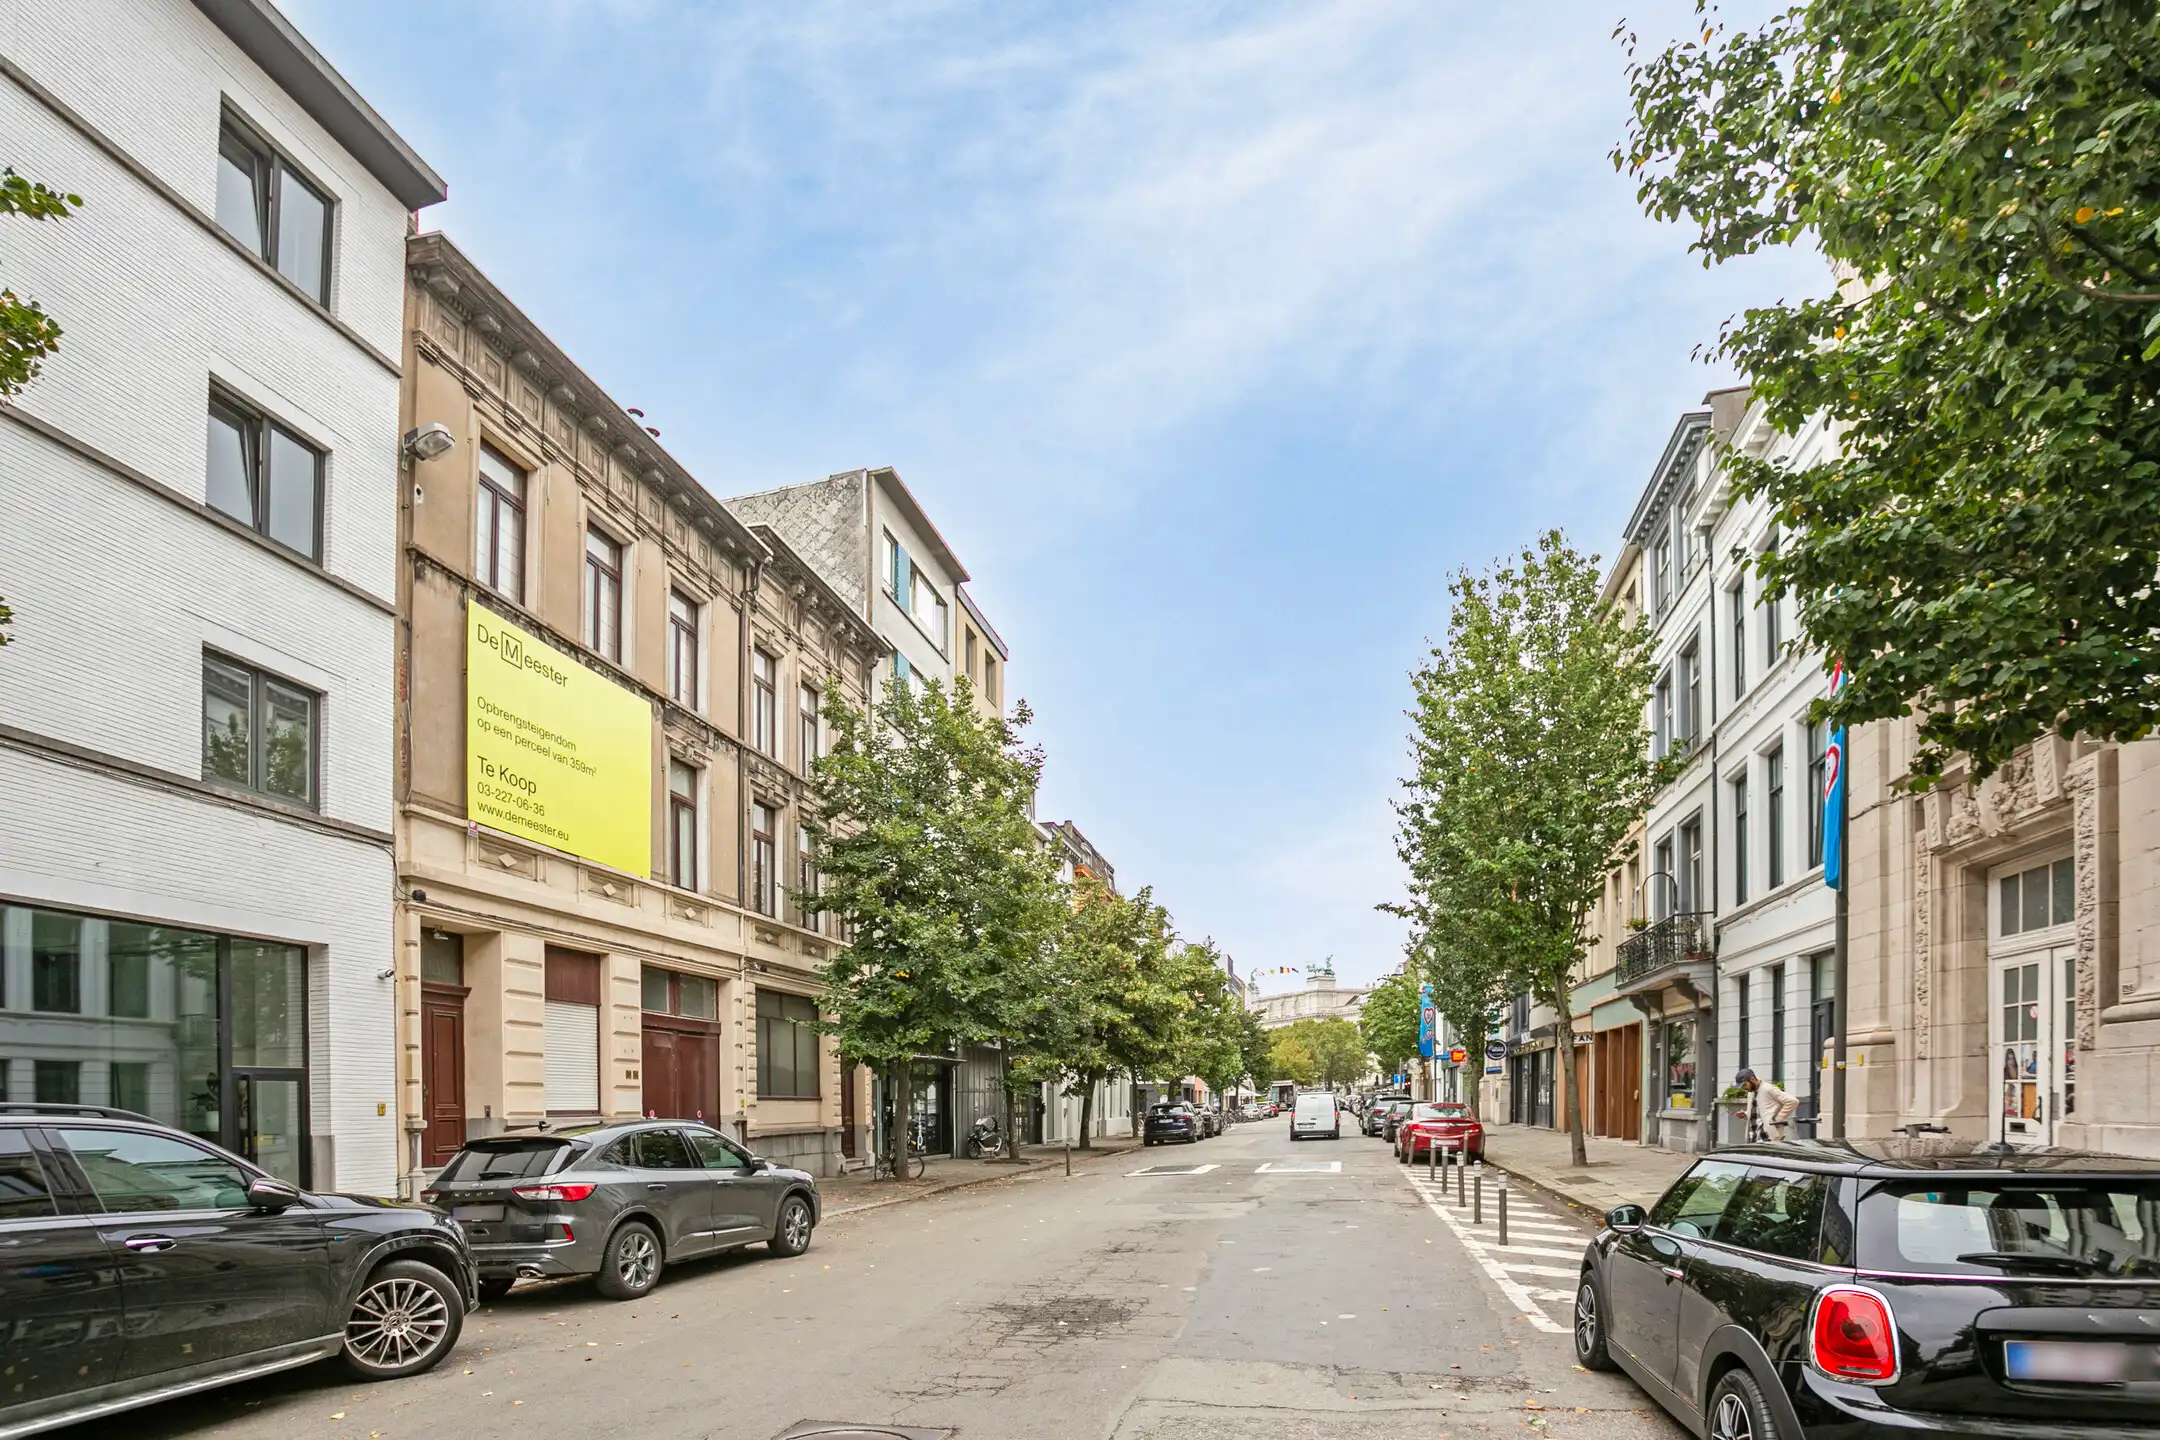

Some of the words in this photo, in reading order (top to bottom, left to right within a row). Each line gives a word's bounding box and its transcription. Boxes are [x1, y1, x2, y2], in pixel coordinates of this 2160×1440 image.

[477, 696, 577, 752] Opbrengsteigendom
[477, 718, 492, 732] op
[493, 725, 513, 741] een
[514, 732, 551, 758] perceel
[552, 750, 568, 765] van
[477, 755, 495, 778] Te
[499, 764, 537, 796] Koop
[477, 781, 545, 817] 03-227-06-36
[477, 801, 569, 841] www.demeester.eu
